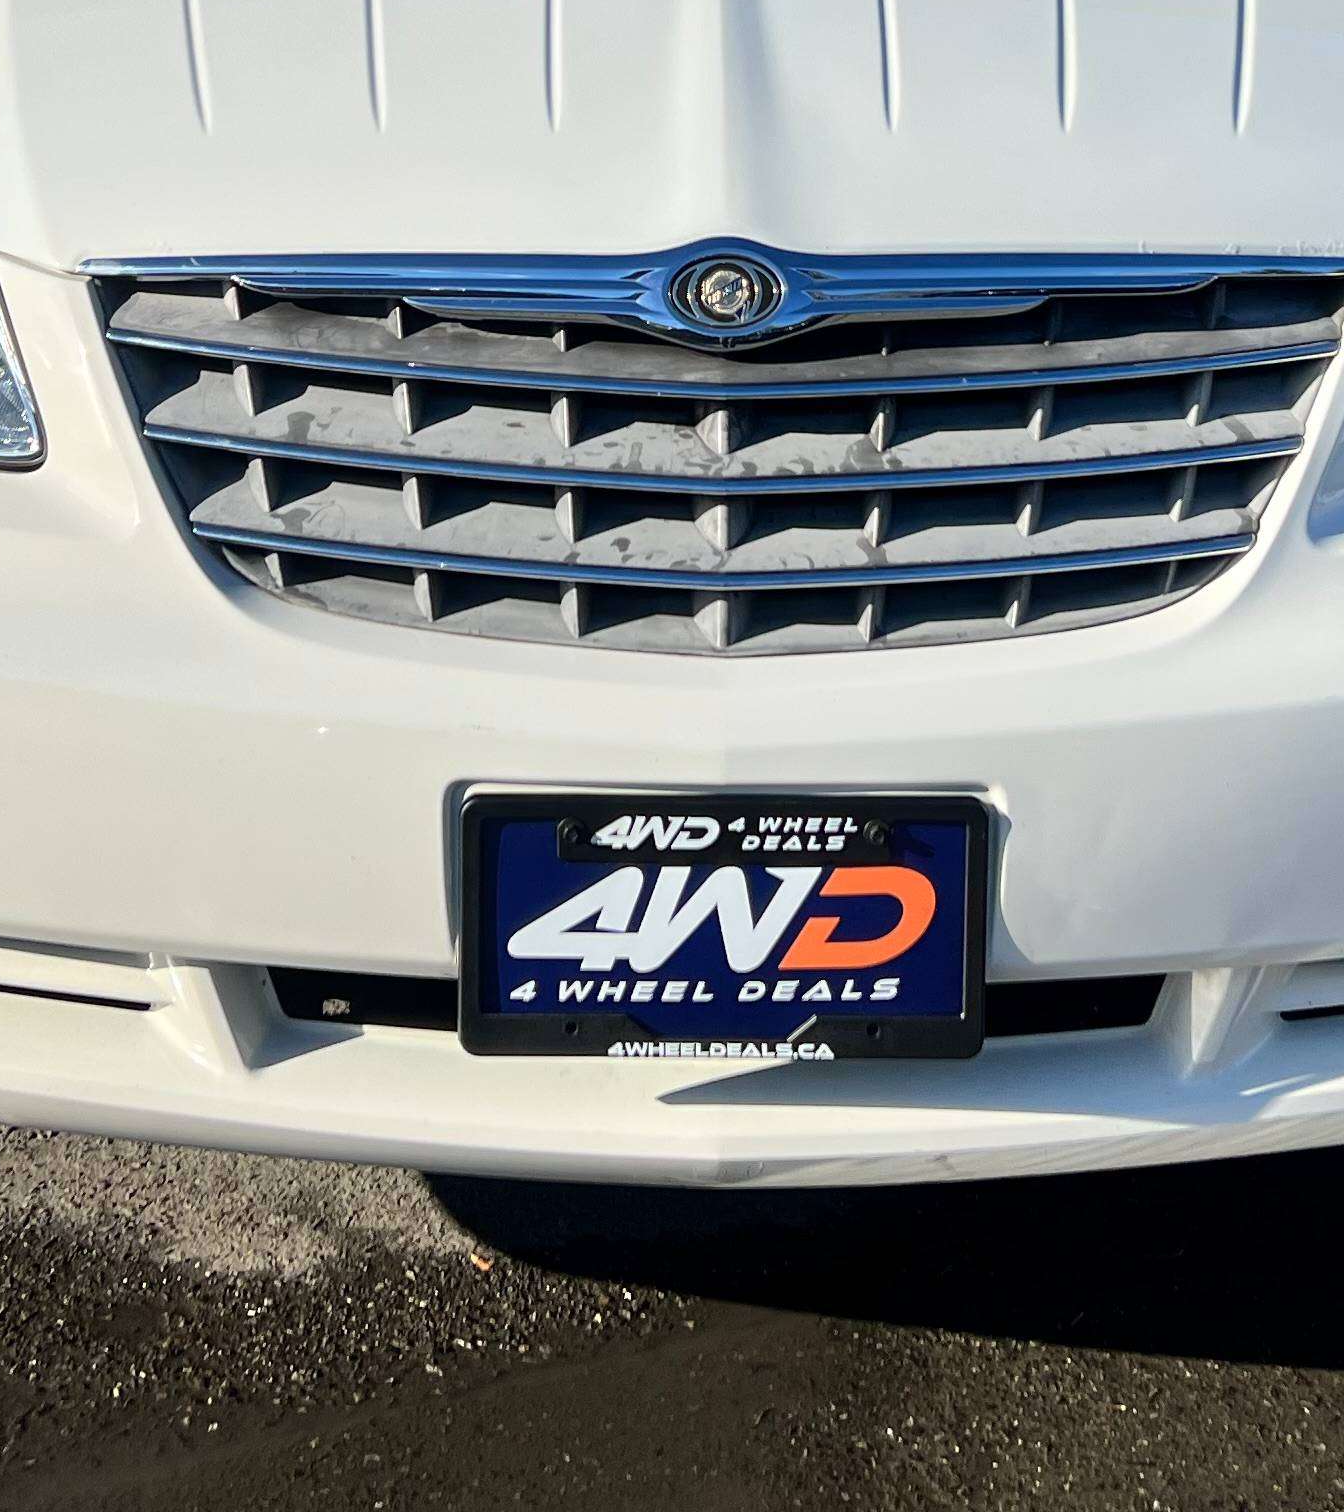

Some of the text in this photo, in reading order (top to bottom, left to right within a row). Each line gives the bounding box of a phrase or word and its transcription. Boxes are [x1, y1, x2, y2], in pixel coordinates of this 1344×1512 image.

[591, 815, 859, 851] 4WD 4 WHEEL
[741, 834, 846, 852] DEALS
[507, 865, 936, 973] 4WD
[509, 977, 901, 1003] 4 WHEEL DEALS
[607, 1041, 835, 1060] 4WHEELDEALS.CA
